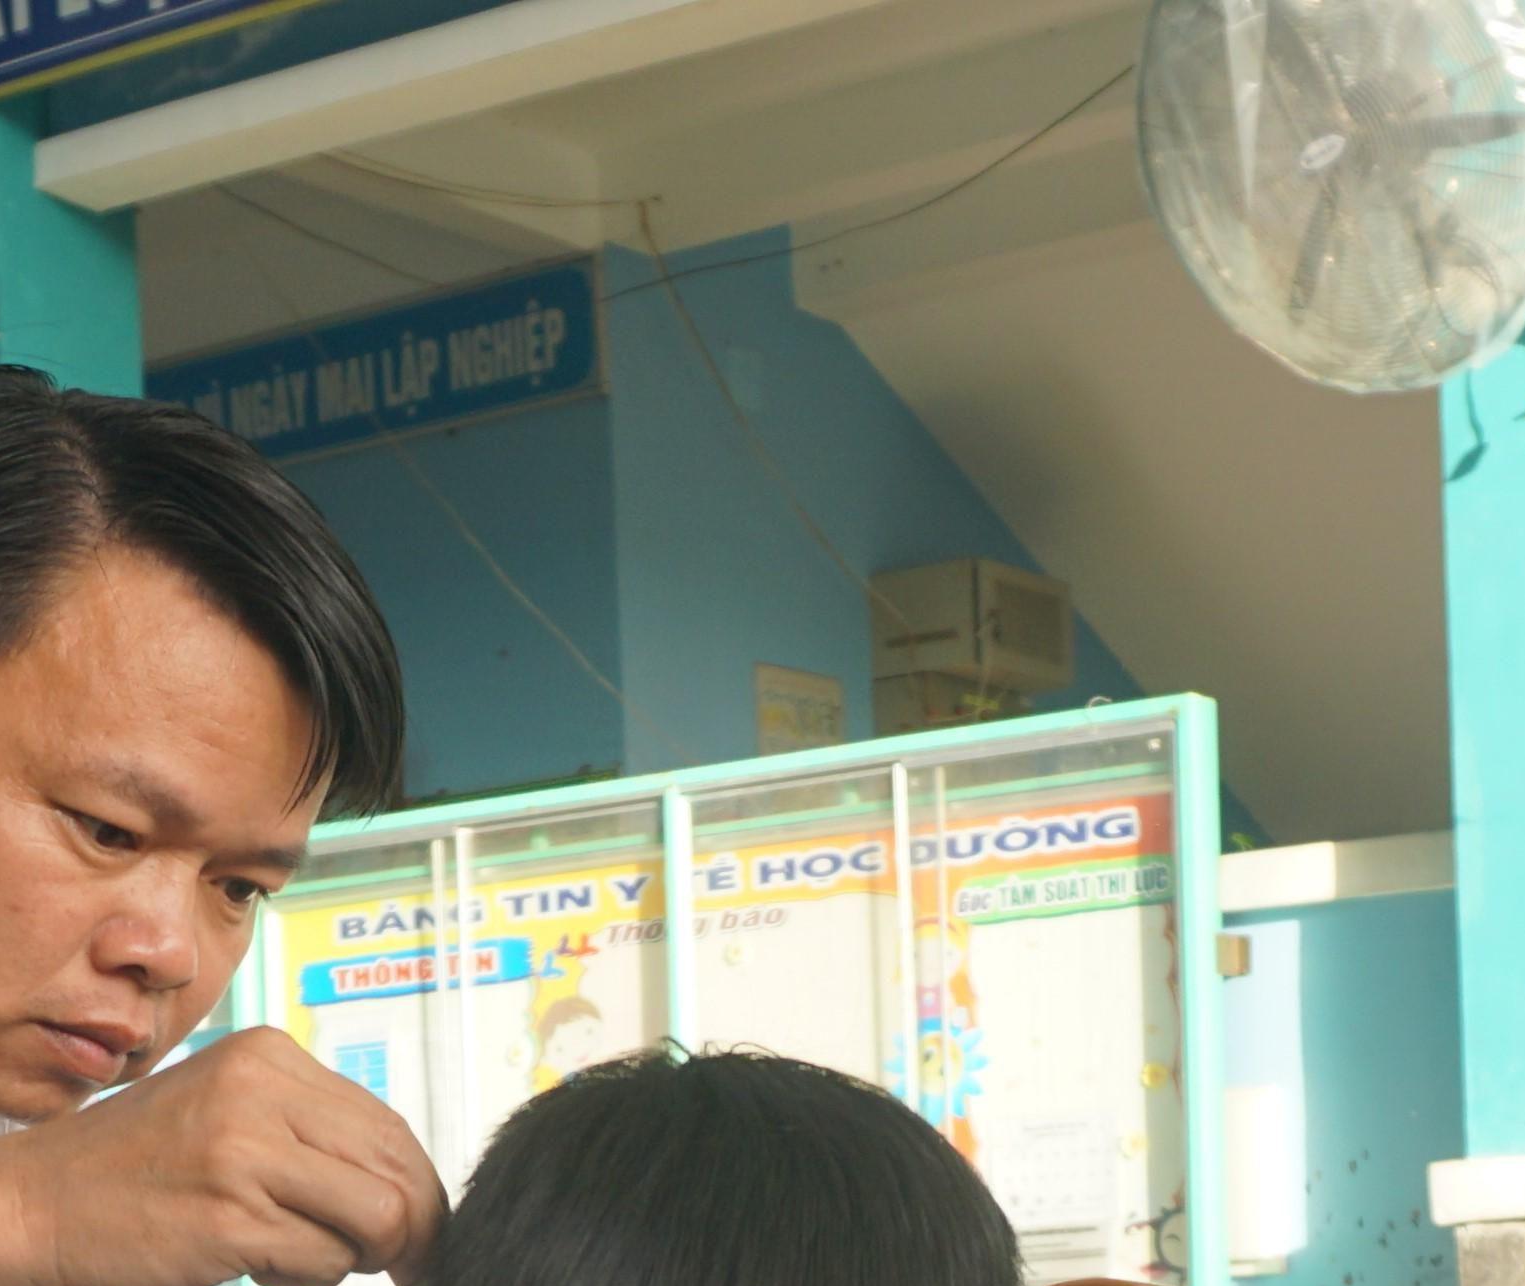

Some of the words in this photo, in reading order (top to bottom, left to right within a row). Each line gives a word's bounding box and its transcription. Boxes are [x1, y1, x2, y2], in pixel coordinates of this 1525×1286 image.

[316, 354, 374, 423] MAI
[383, 331, 439, 415] LẬP
[448, 299, 566, 387] NGHIỆP
[503, 886, 592, 917] TIN
[614, 876, 650, 901] Y
[759, 846, 881, 885] HỌC
[607, 916, 707, 944] Thôg
[335, 957, 438, 989] THÔNG
[447, 950, 494, 977] TN
